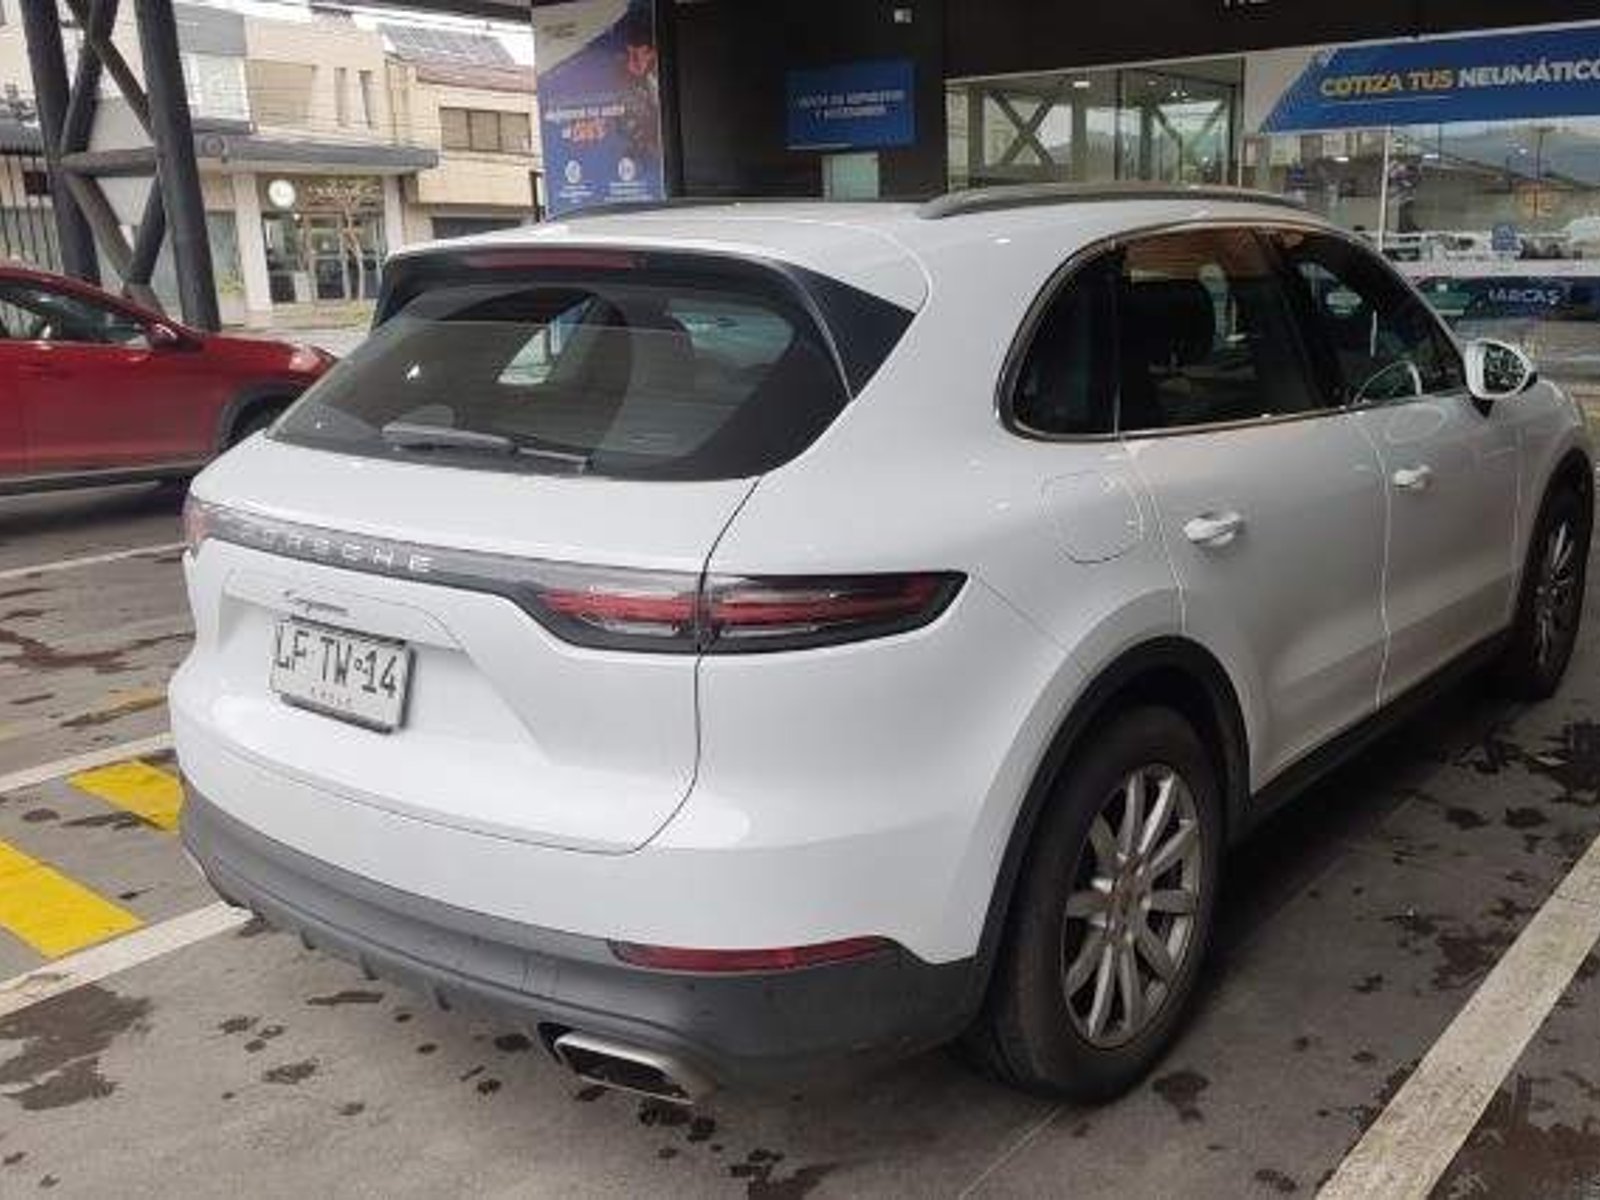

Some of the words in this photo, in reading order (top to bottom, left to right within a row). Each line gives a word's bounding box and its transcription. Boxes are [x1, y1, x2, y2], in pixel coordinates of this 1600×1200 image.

[1320, 74, 1403, 96] COTIZA
[1409, 70, 1453, 90] TUS
[319, 635, 353, 687] TW
[360, 649, 398, 699] 14
